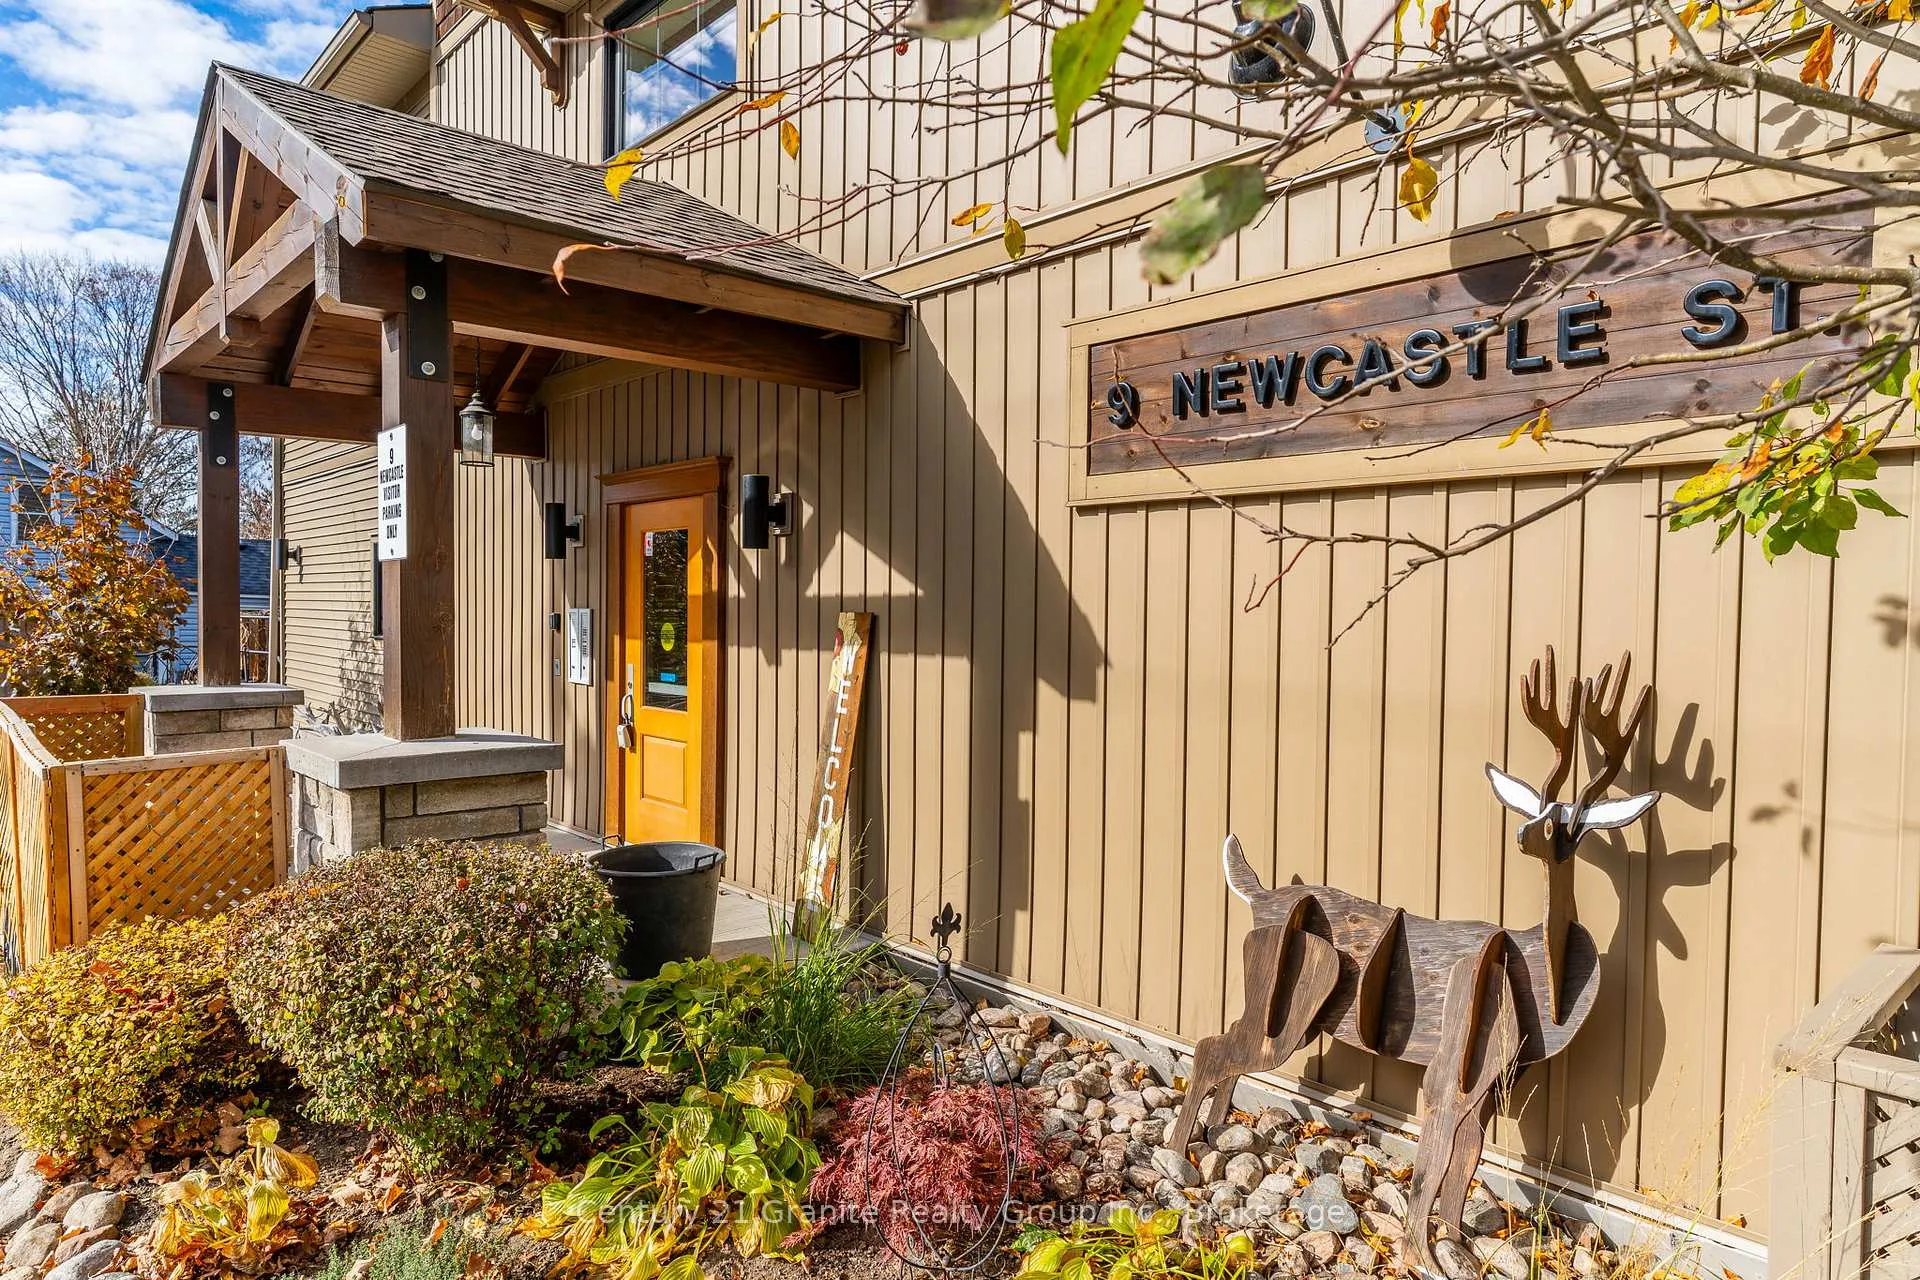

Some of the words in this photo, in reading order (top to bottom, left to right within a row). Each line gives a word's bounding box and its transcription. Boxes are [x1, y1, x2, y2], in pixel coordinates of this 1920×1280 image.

[1107, 382, 1138, 429] 9
[1172, 300, 1604, 418] NEWCASTLE
[1681, 277, 1834, 347] ST
[389, 448, 394, 465] 9
[380, 464, 404, 484] NEWCASTLE
[383, 484, 400, 501] VISITOR
[382, 504, 402, 521] PARKING
[386, 524, 398, 539] ONLY
